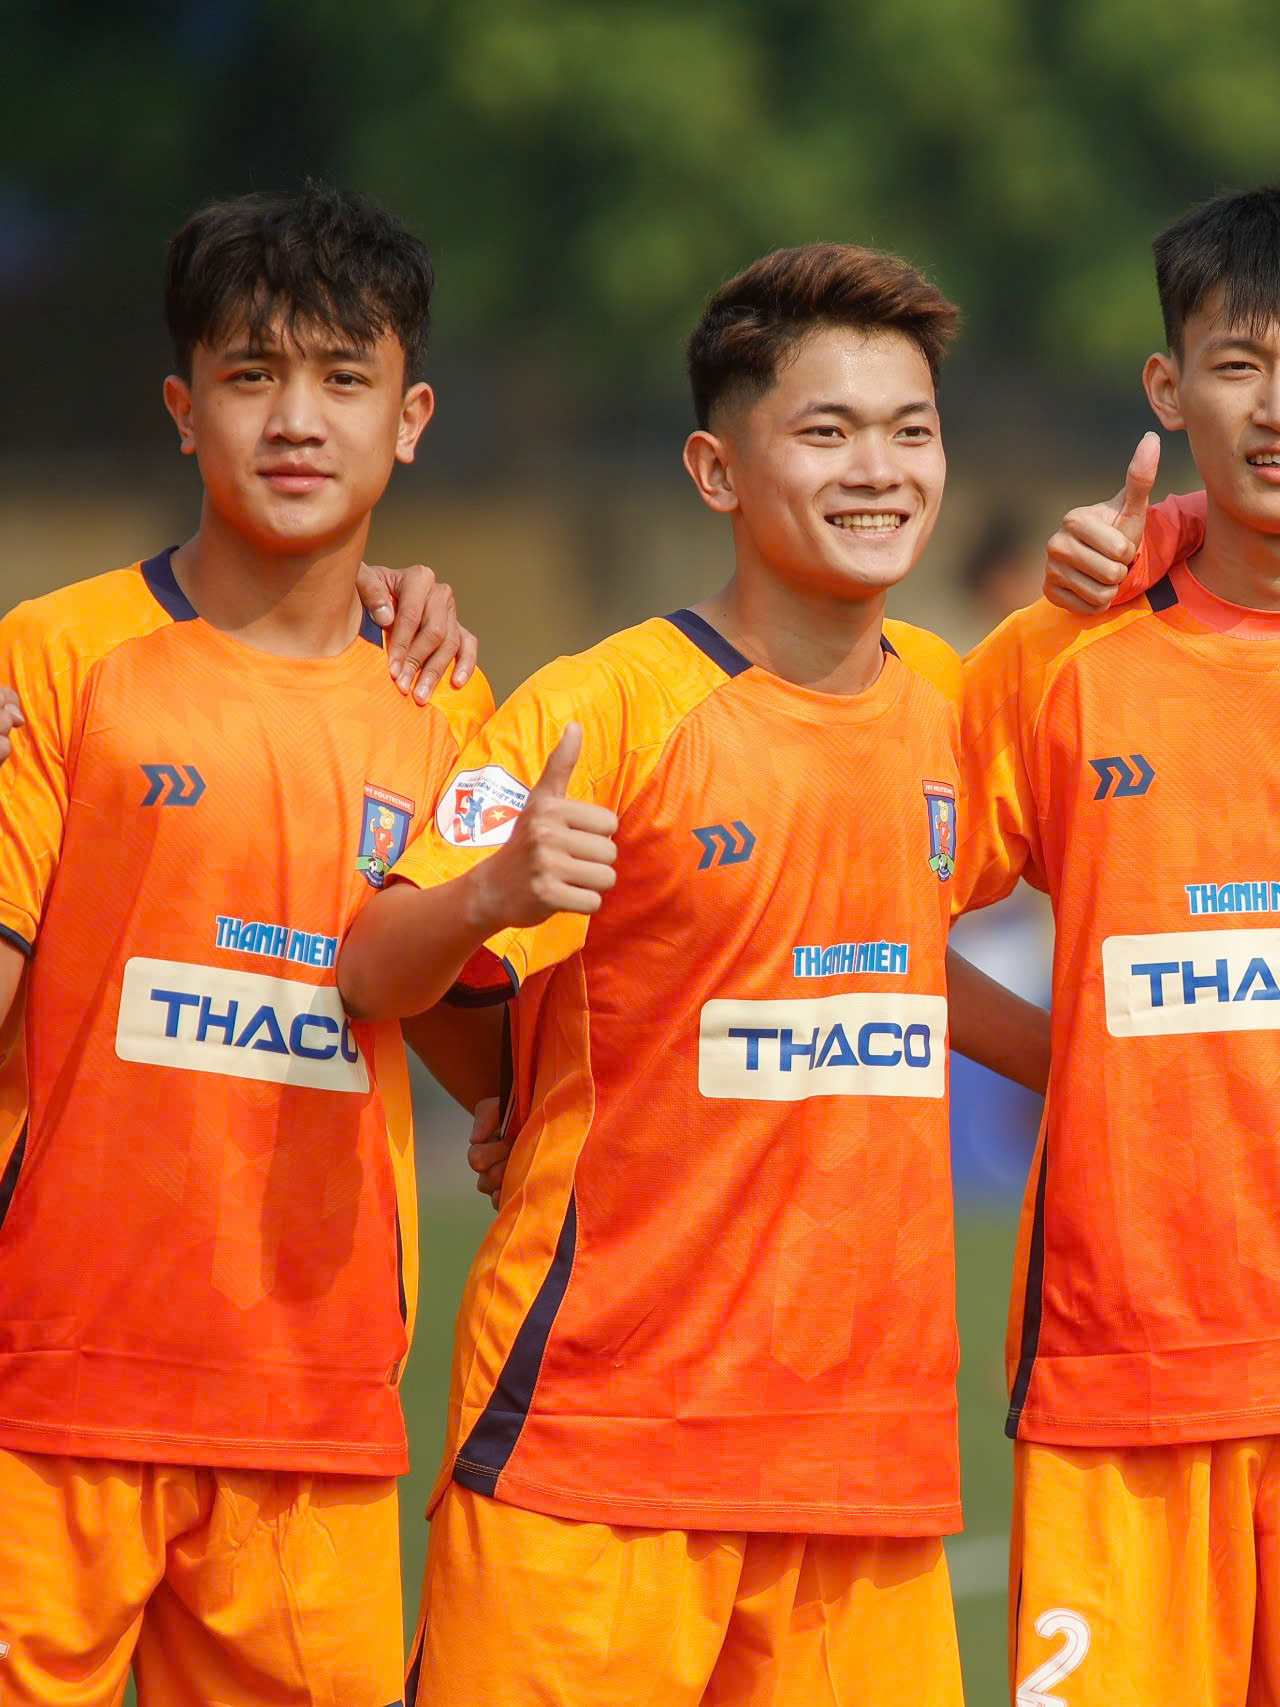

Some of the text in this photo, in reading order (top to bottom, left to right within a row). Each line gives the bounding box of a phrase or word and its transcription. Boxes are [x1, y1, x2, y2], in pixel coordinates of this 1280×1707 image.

[374, 790, 412, 810] POLYTECHNIC
[1185, 881, 1269, 915] THANH
[216, 915, 338, 968] THANH NIÊN
[792, 939, 908, 977] THANH NIÊN
[728, 1022, 931, 1072] THACO
[1016, 1608, 1091, 1707] 2
